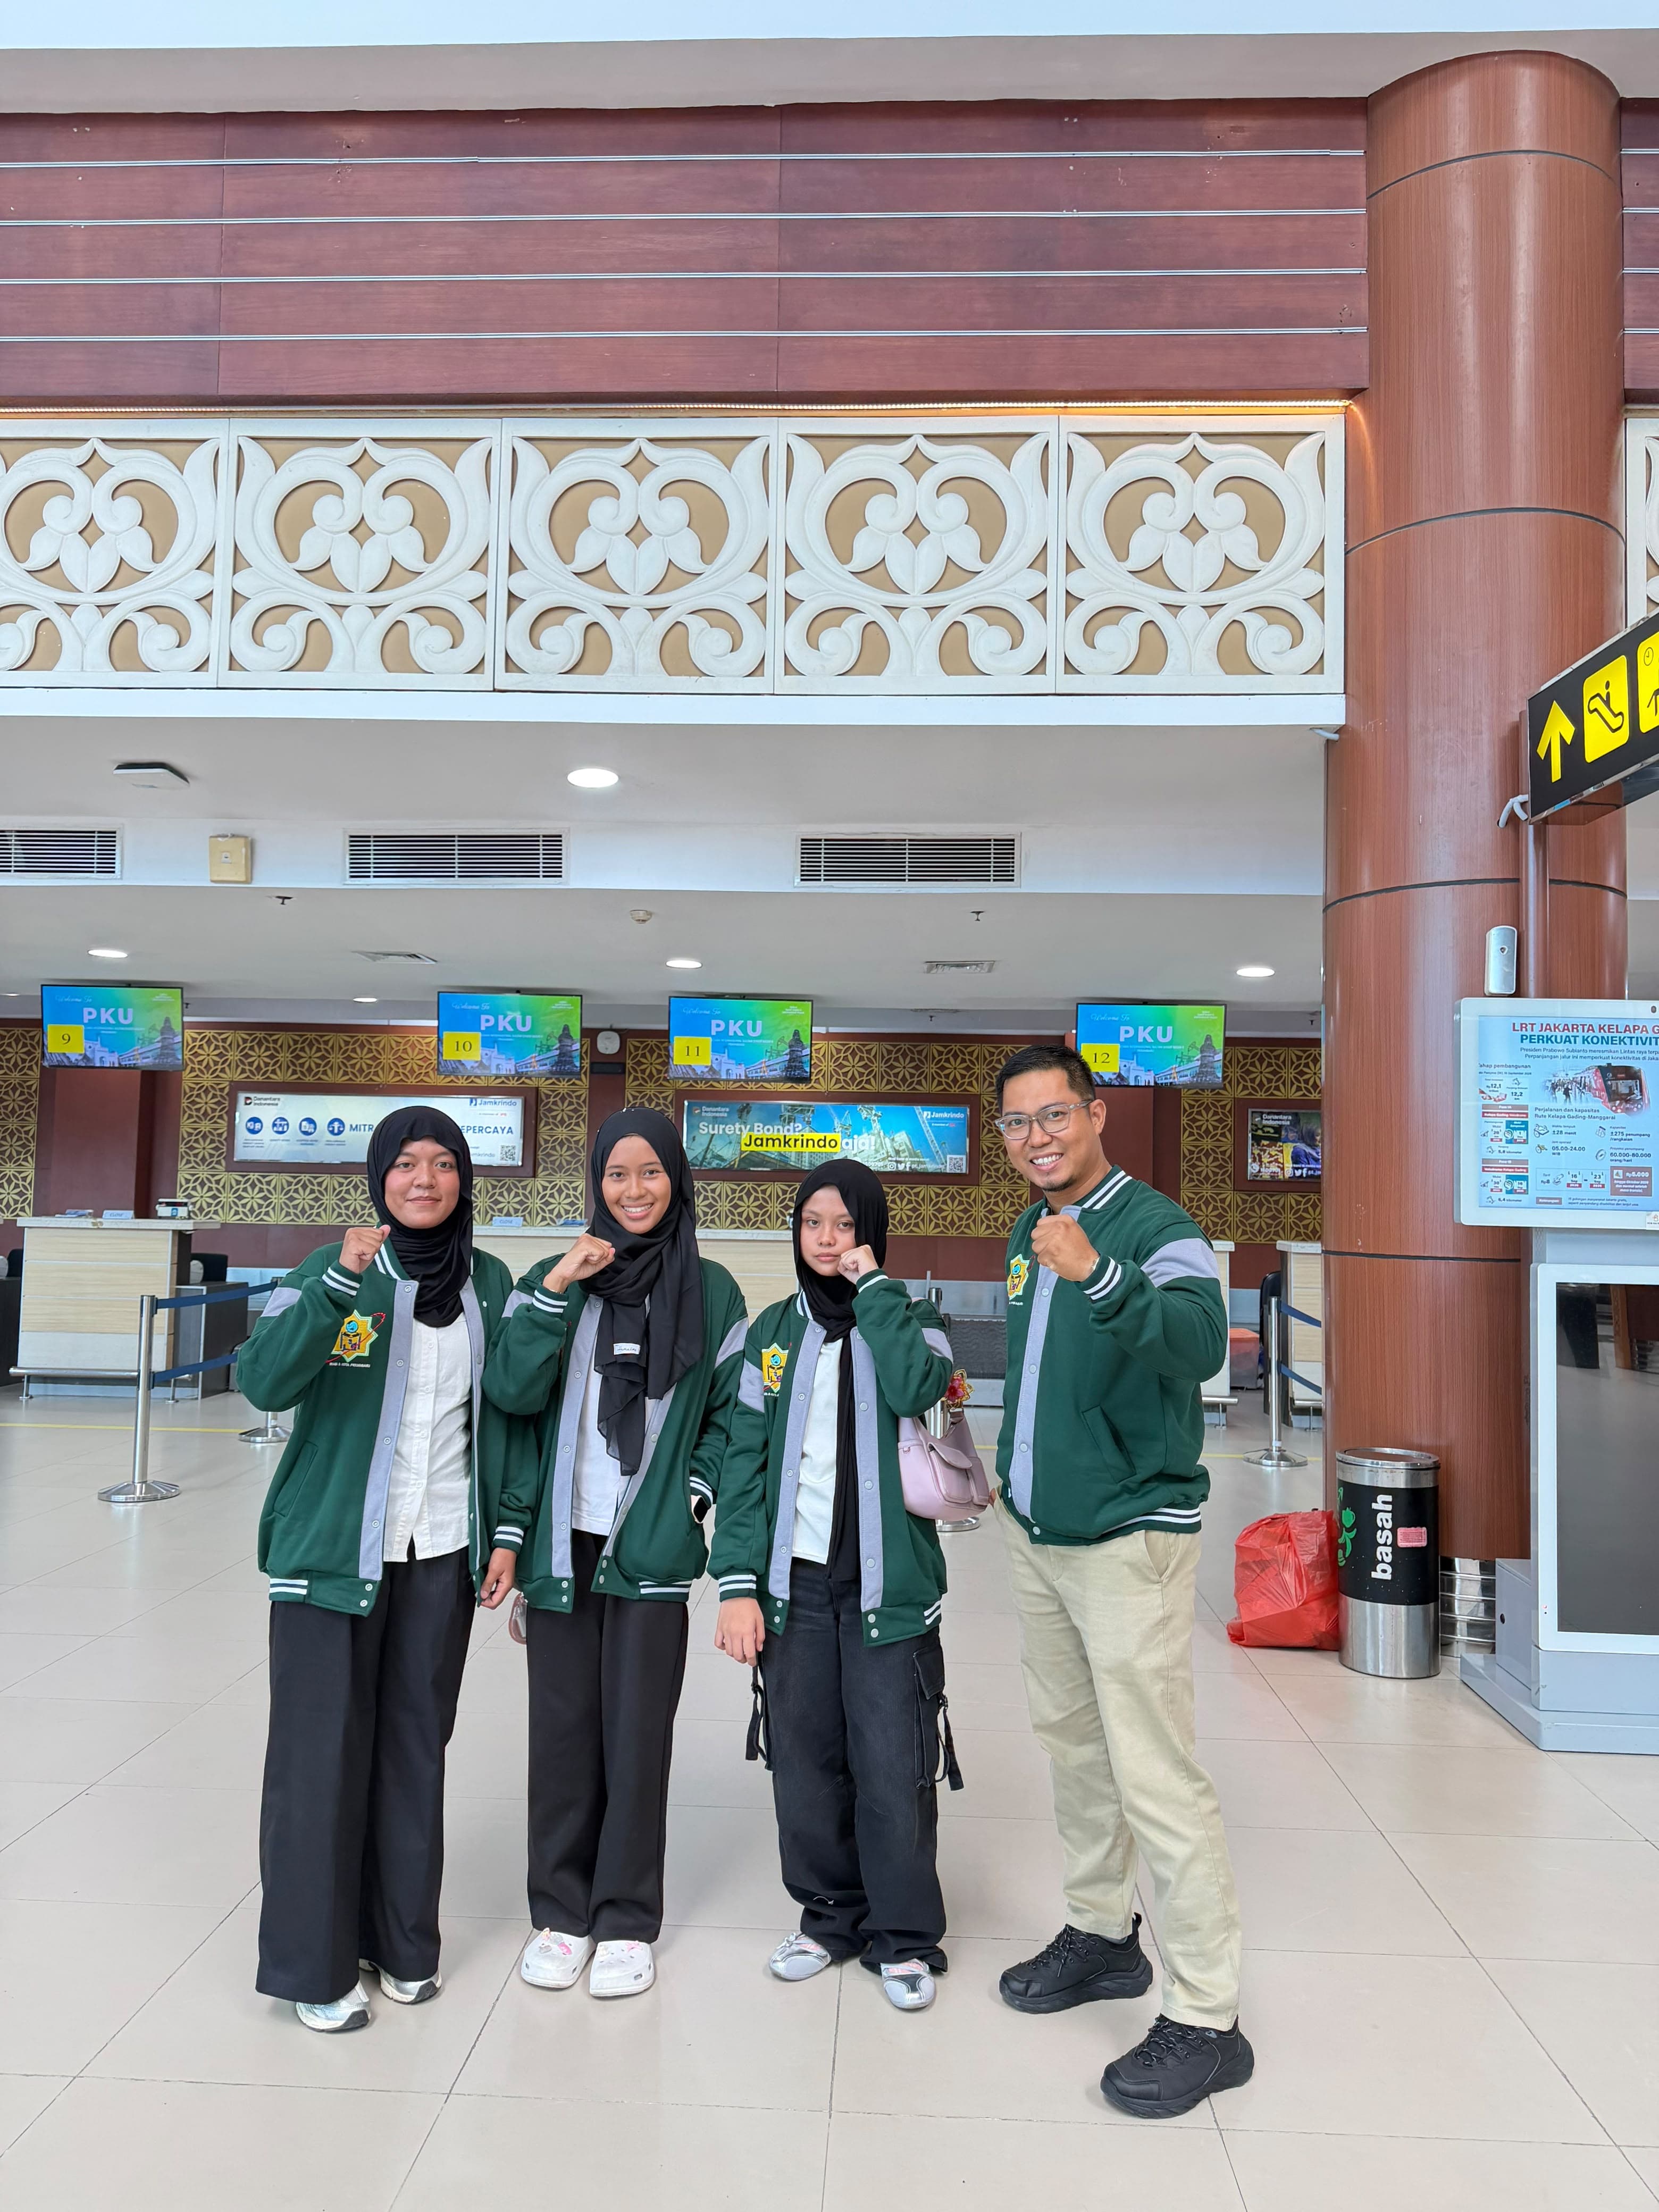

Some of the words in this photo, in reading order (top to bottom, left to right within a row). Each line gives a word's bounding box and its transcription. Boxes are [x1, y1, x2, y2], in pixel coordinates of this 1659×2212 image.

[83, 1008, 133, 1025] PKU
[480, 1015, 531, 1032] PKU
[711, 1019, 762, 1036] PKU
[1512, 1023, 1536, 1032] LRT
[1538, 1023, 1595, 1033] JAKARTA
[1598, 1024, 1649, 1034] KELAPA
[62, 1033, 71, 1045] 9
[1119, 1026, 1173, 1043] PKU
[1520, 1034, 1580, 1044] PERKUAT
[455, 1041, 472, 1052] 10
[686, 1046, 700, 1057] 11
[1093, 1053, 1110, 1063] 12
[349, 1124, 374, 1132] MITR
[460, 1126, 513, 1134] EPERCAYA
[699, 1122, 750, 1137] Surety
[754, 1122, 802, 1136] Bond?
[744, 1134, 838, 1149] Jamkrindo
[842, 1135, 875, 1151] aja!
[1371, 1494, 1393, 1580] basah
